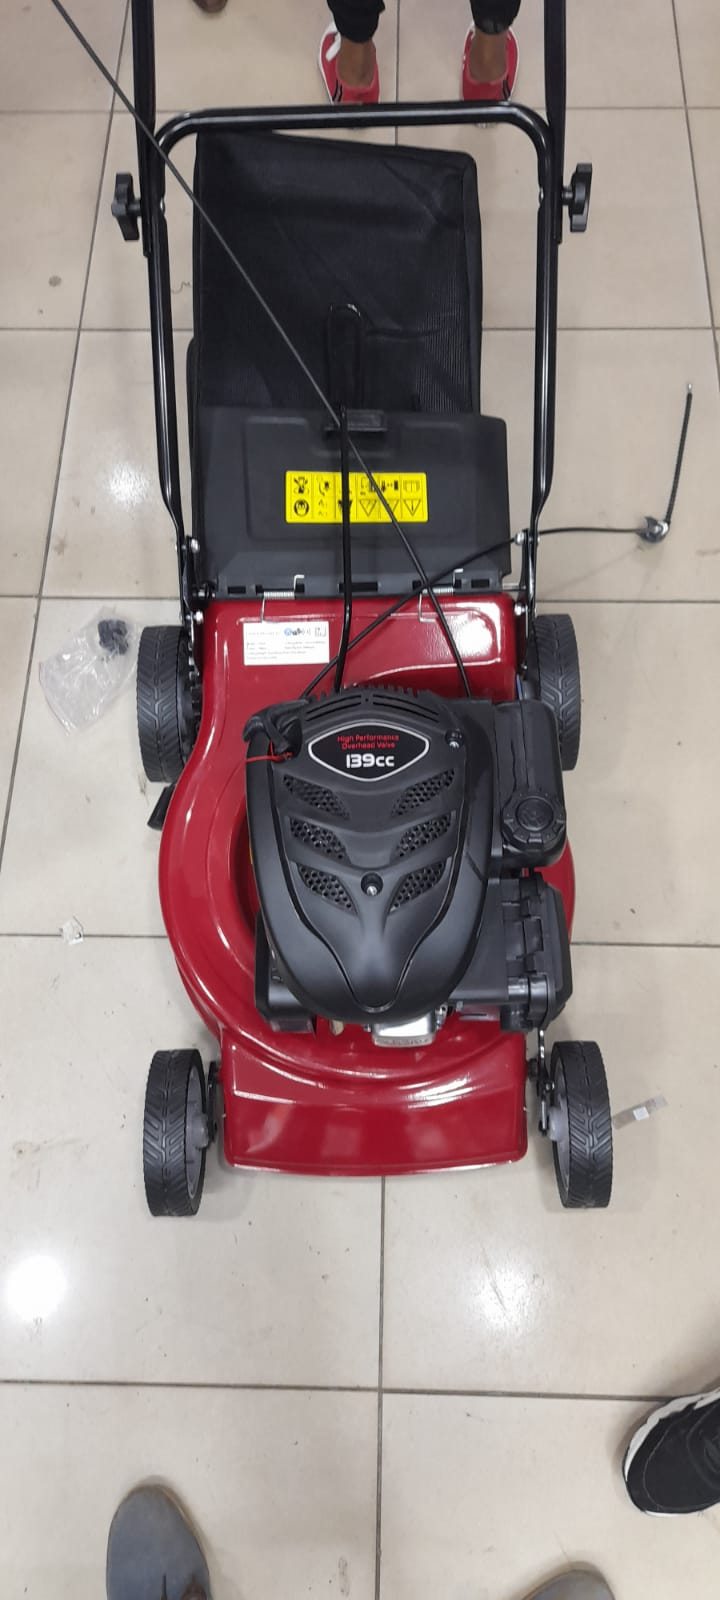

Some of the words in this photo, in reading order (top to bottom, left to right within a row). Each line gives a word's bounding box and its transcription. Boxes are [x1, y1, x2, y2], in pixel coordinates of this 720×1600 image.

[337, 735, 354, 743] High
[355, 734, 399, 742] Performance
[341, 742, 375, 750] Overhead
[346, 753, 395, 768] 139cc
